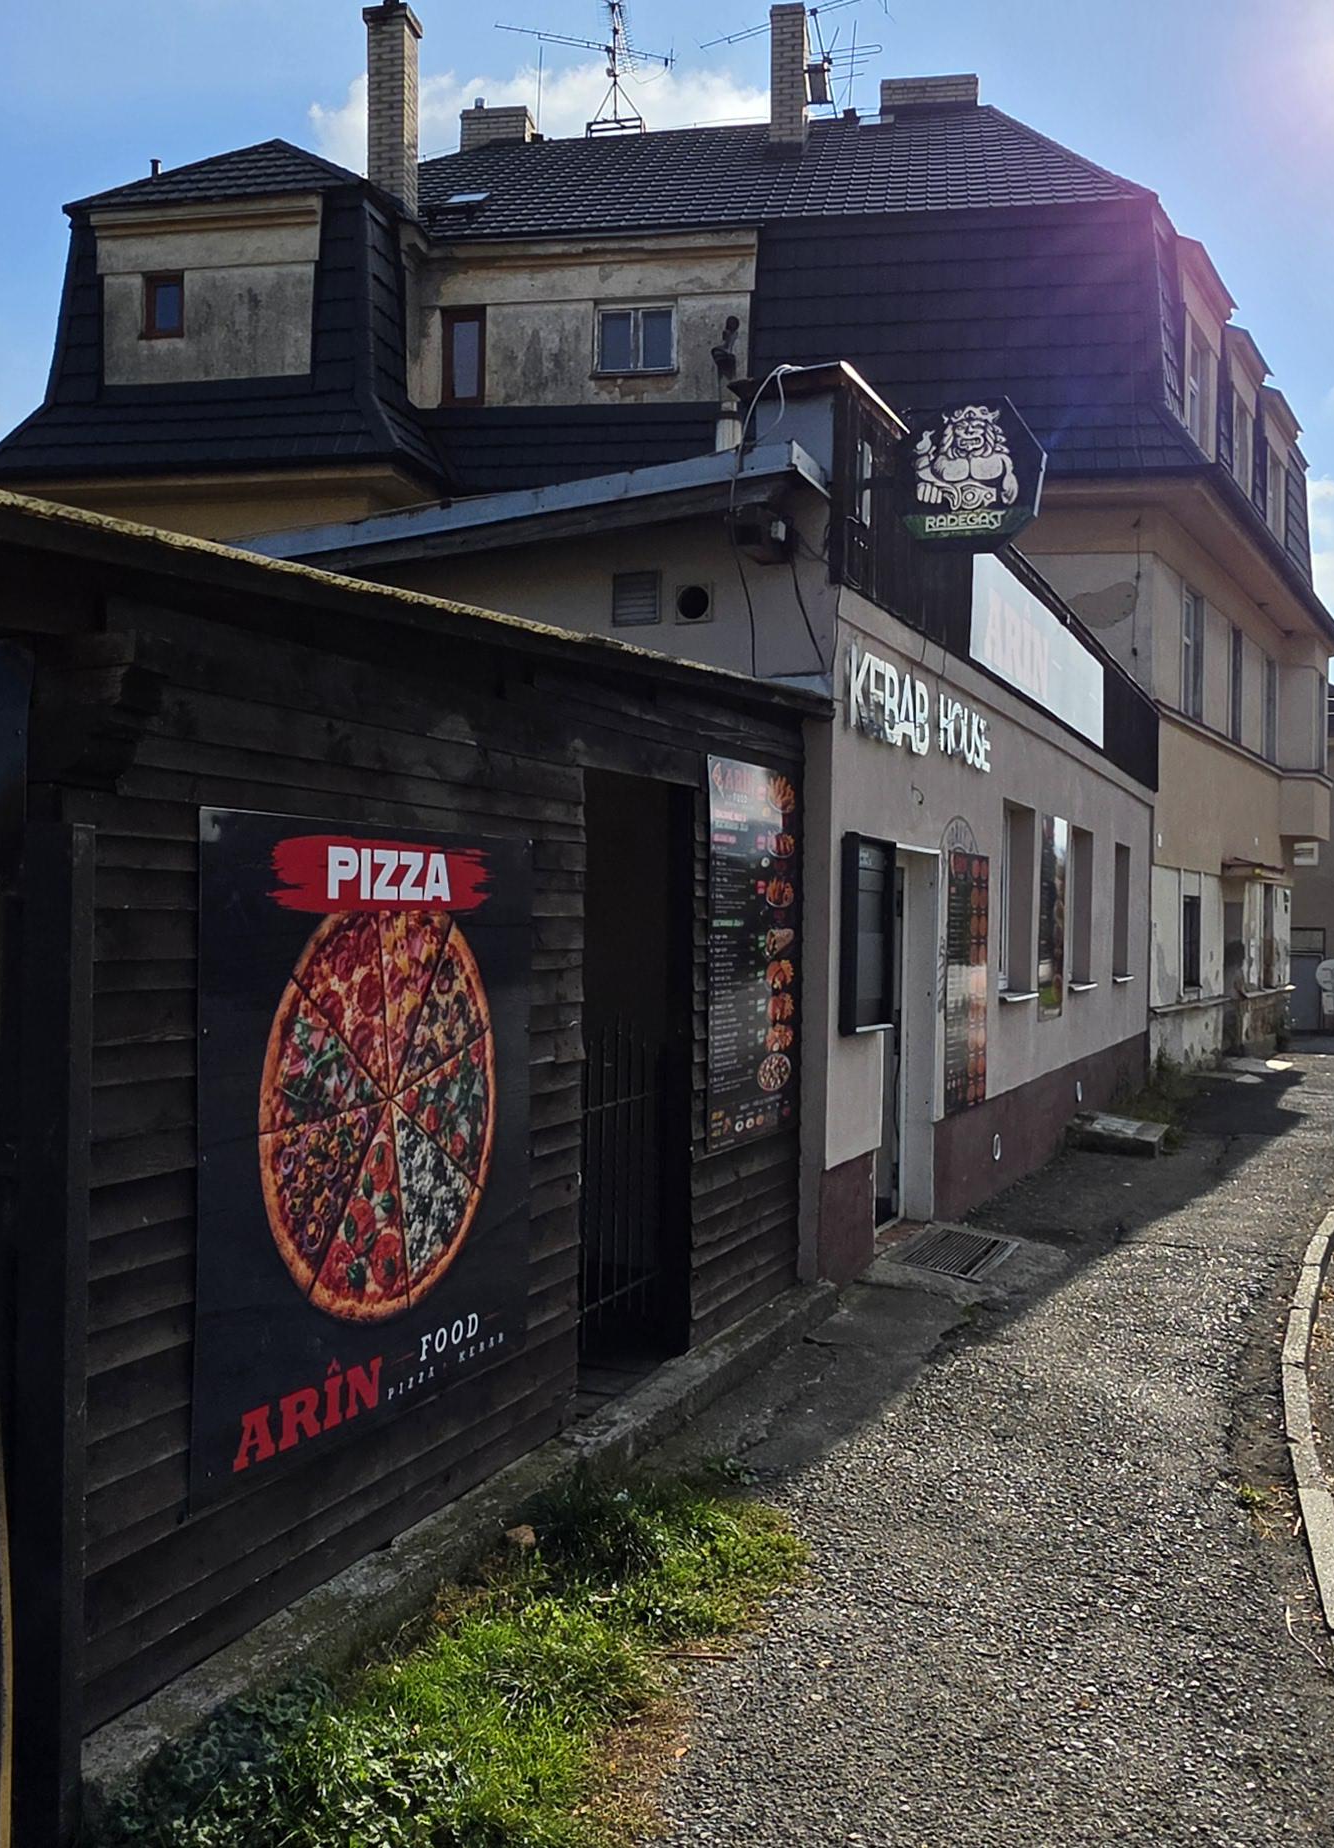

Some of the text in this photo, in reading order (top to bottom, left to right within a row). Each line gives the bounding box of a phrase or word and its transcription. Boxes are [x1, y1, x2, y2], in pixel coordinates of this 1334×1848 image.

[925, 510, 1006, 532] RADEGAST
[850, 643, 991, 772] KEBAB HOUSE
[327, 845, 451, 902] PIZZA
[419, 1312, 479, 1362] FOOD
[387, 1366, 435, 1401] PIZZA
